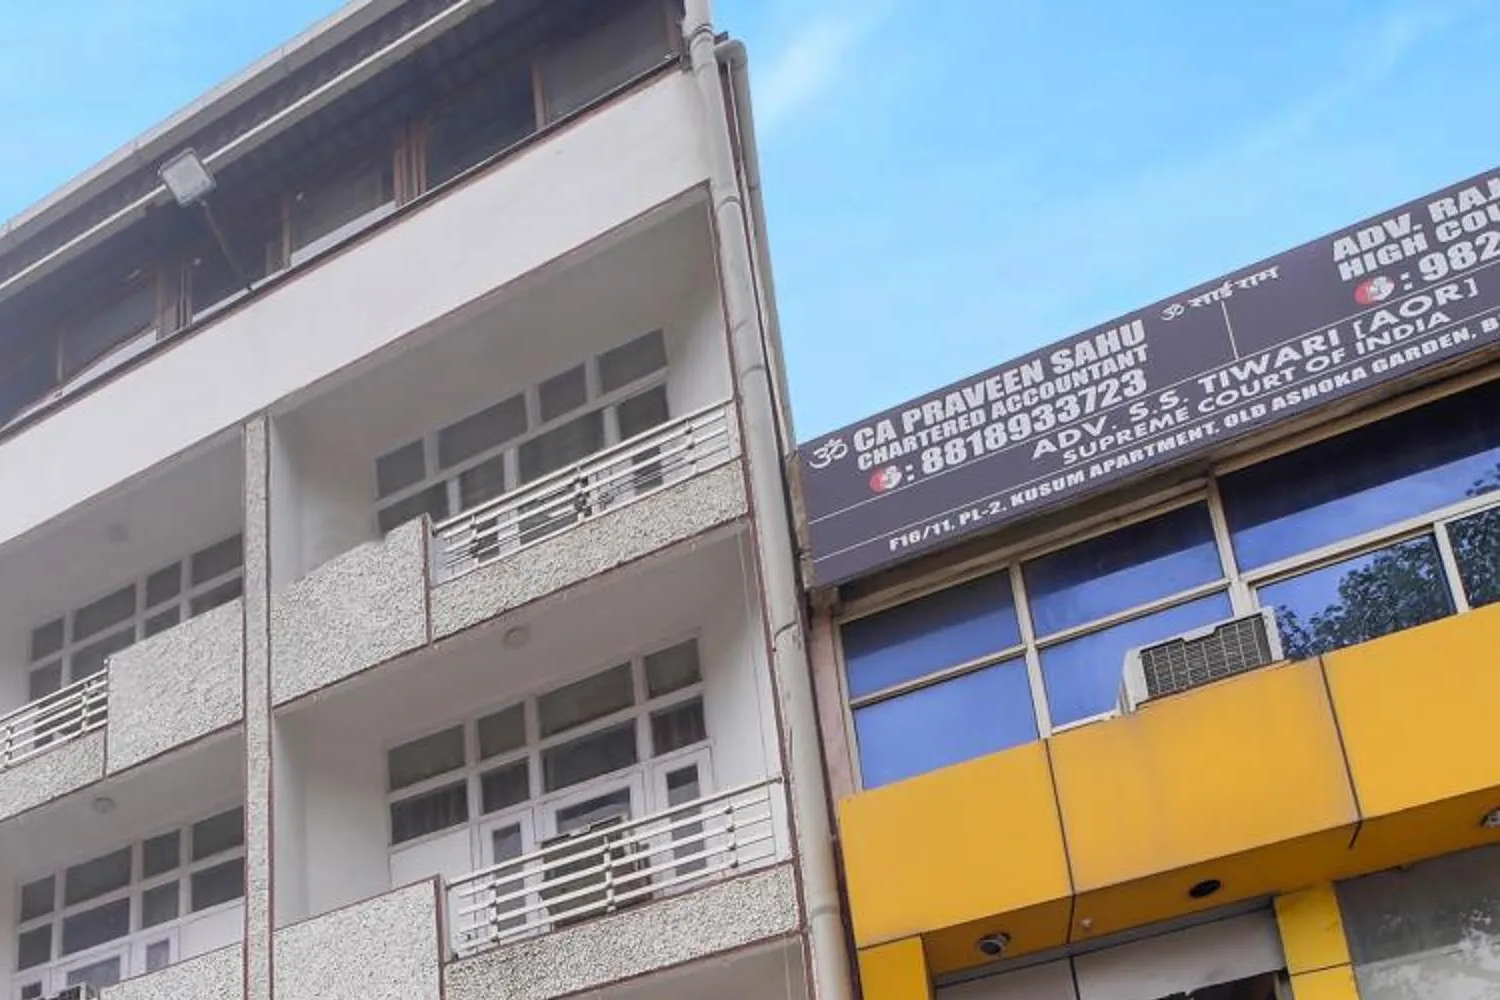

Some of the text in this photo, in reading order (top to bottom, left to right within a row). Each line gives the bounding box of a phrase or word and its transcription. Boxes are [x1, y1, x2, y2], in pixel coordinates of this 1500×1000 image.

[1332, 212, 1423, 262] ADV.
[1337, 232, 1428, 281] HIGH
[853, 319, 1146, 453] CA PRAVEEN SAHU
[857, 343, 1149, 471] CHARTERED ACCOUNTANT
[921, 368, 1148, 475] 8818933723
[1010, 469, 1085, 508] KUSUM
[1224, 403, 1267, 429] OLD
[1271, 367, 1368, 412] ASHOKA
[1481, 313, 1500, 334] B
[1031, 278, 1479, 461] ADV. S.S. TIWARI [AOR]
[1062, 311, 1452, 466] SUPREME COURT OF INDIA
